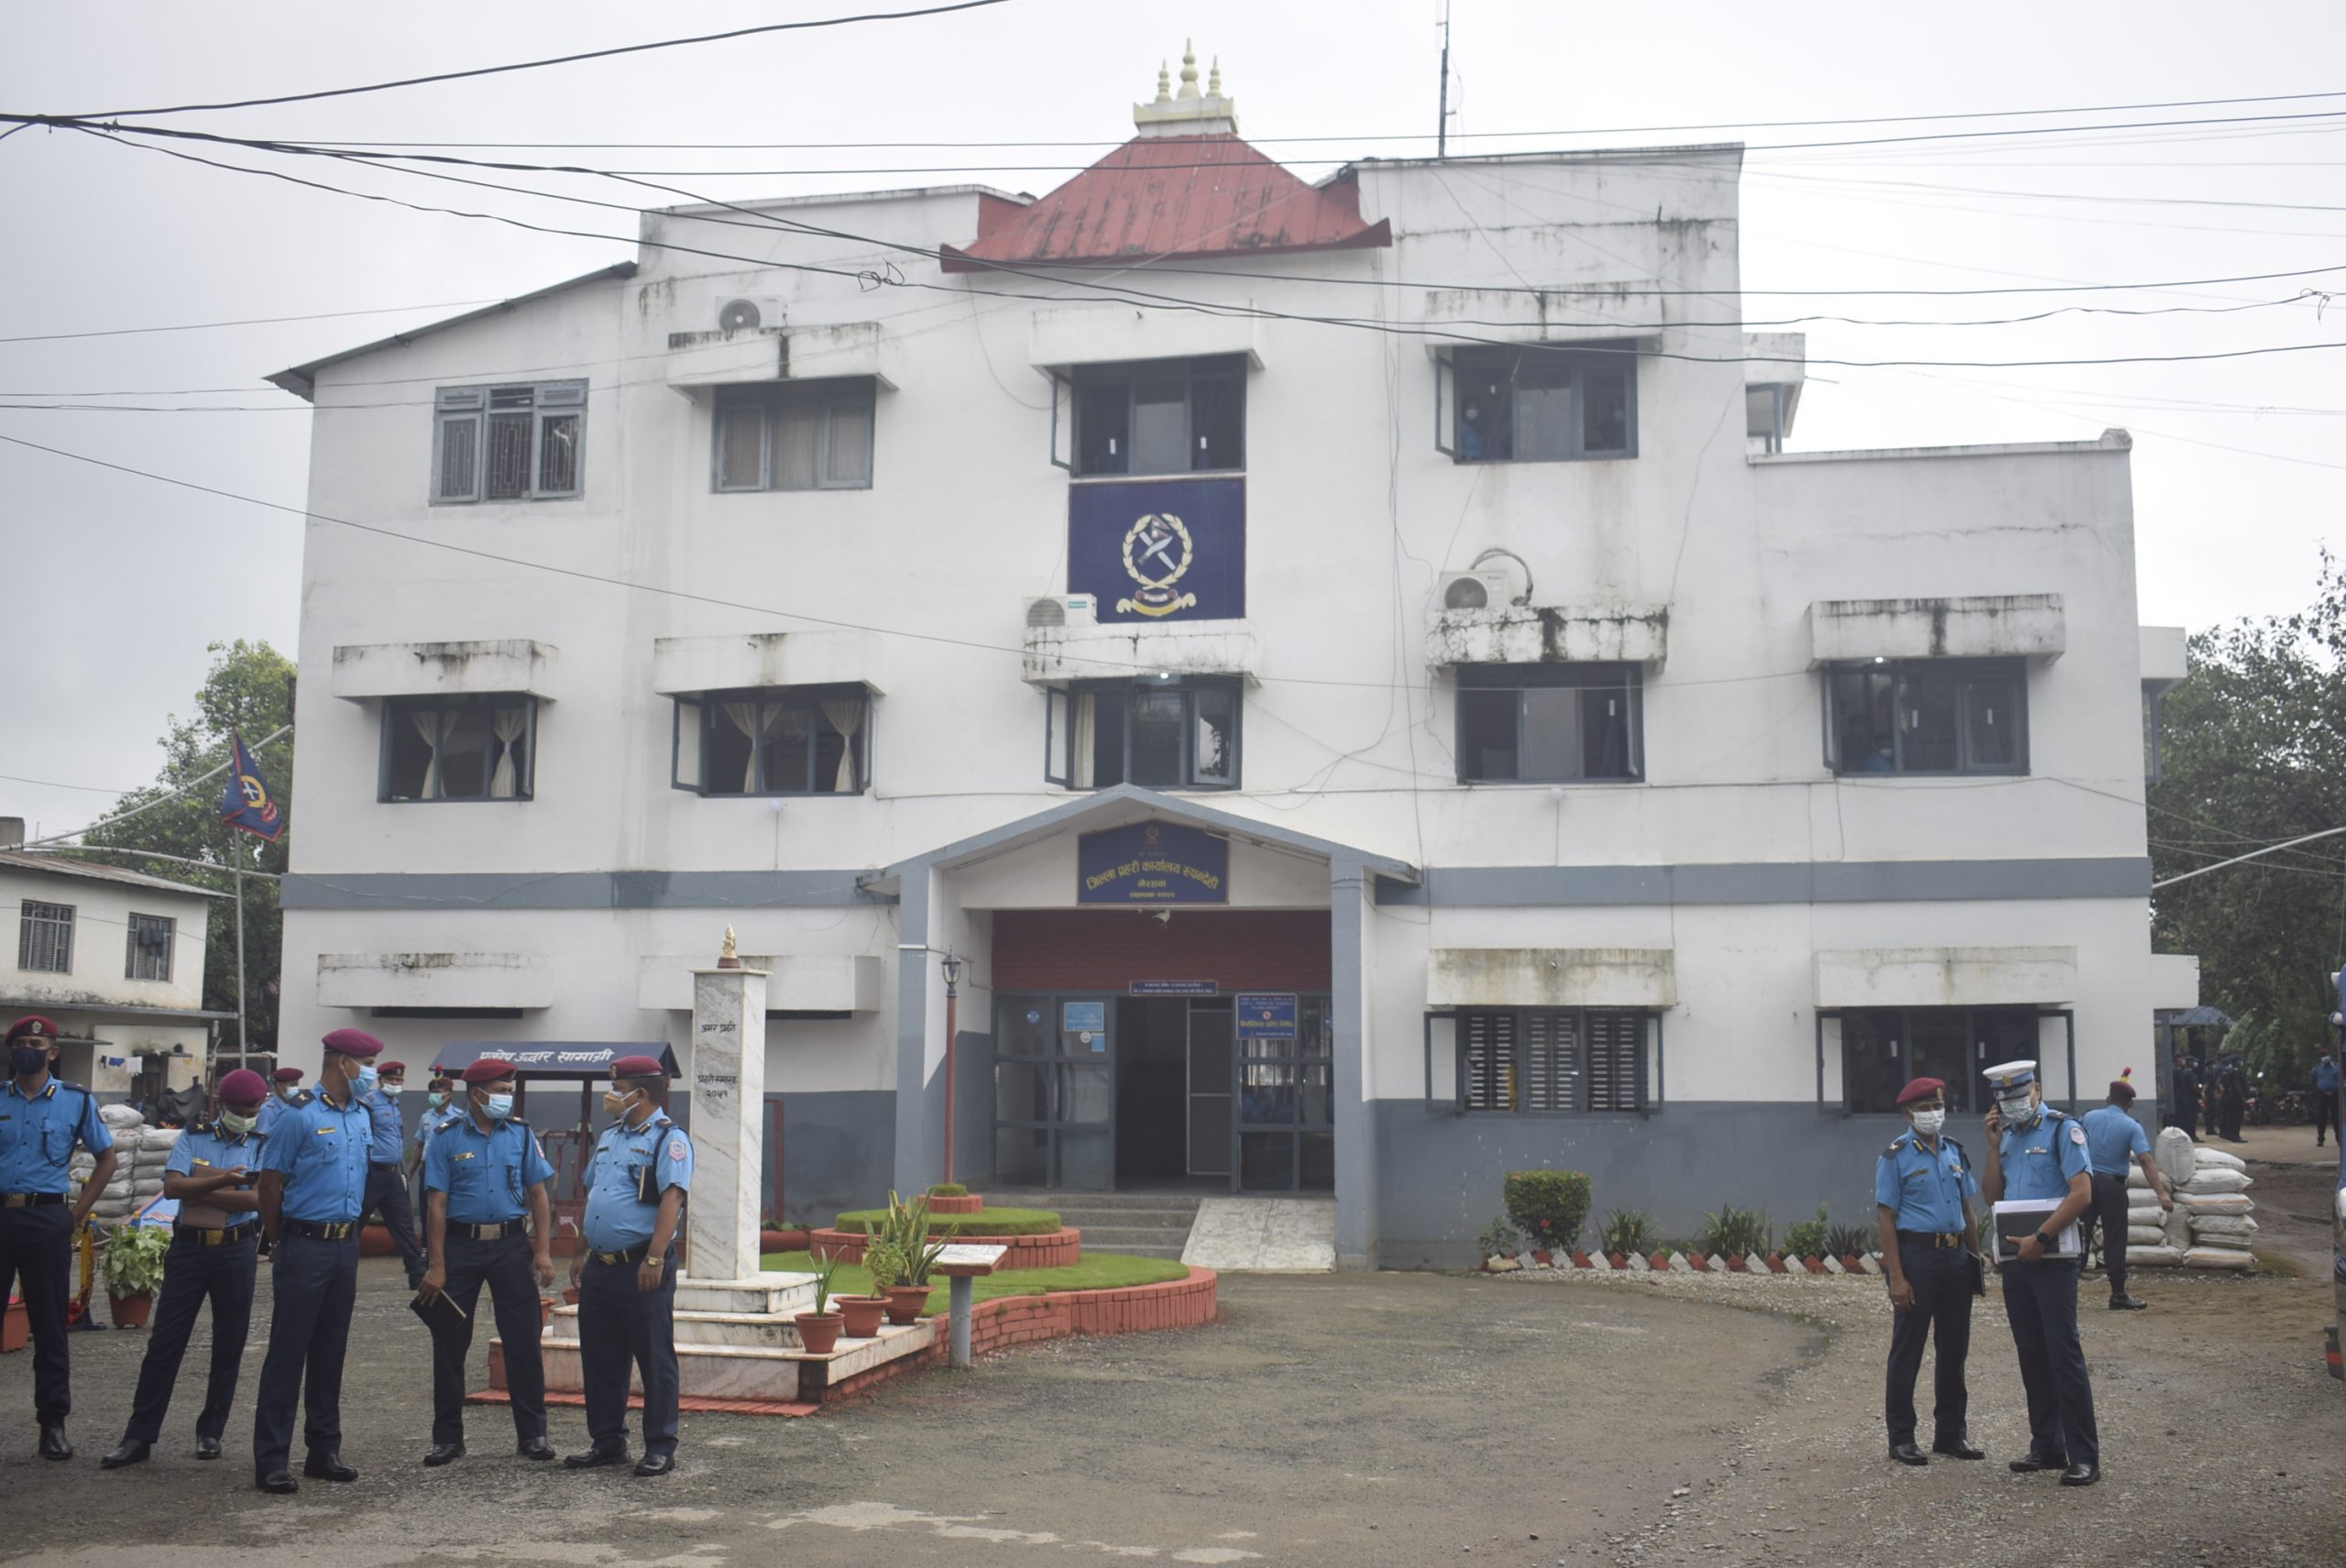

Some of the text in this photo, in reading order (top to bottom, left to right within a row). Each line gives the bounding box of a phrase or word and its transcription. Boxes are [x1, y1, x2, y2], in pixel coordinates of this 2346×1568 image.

[1086, 869, 1116, 891] जिल्ला
[1118, 860, 1139, 877] प्रहरी
[1142, 859, 1180, 874] कार्यालय
